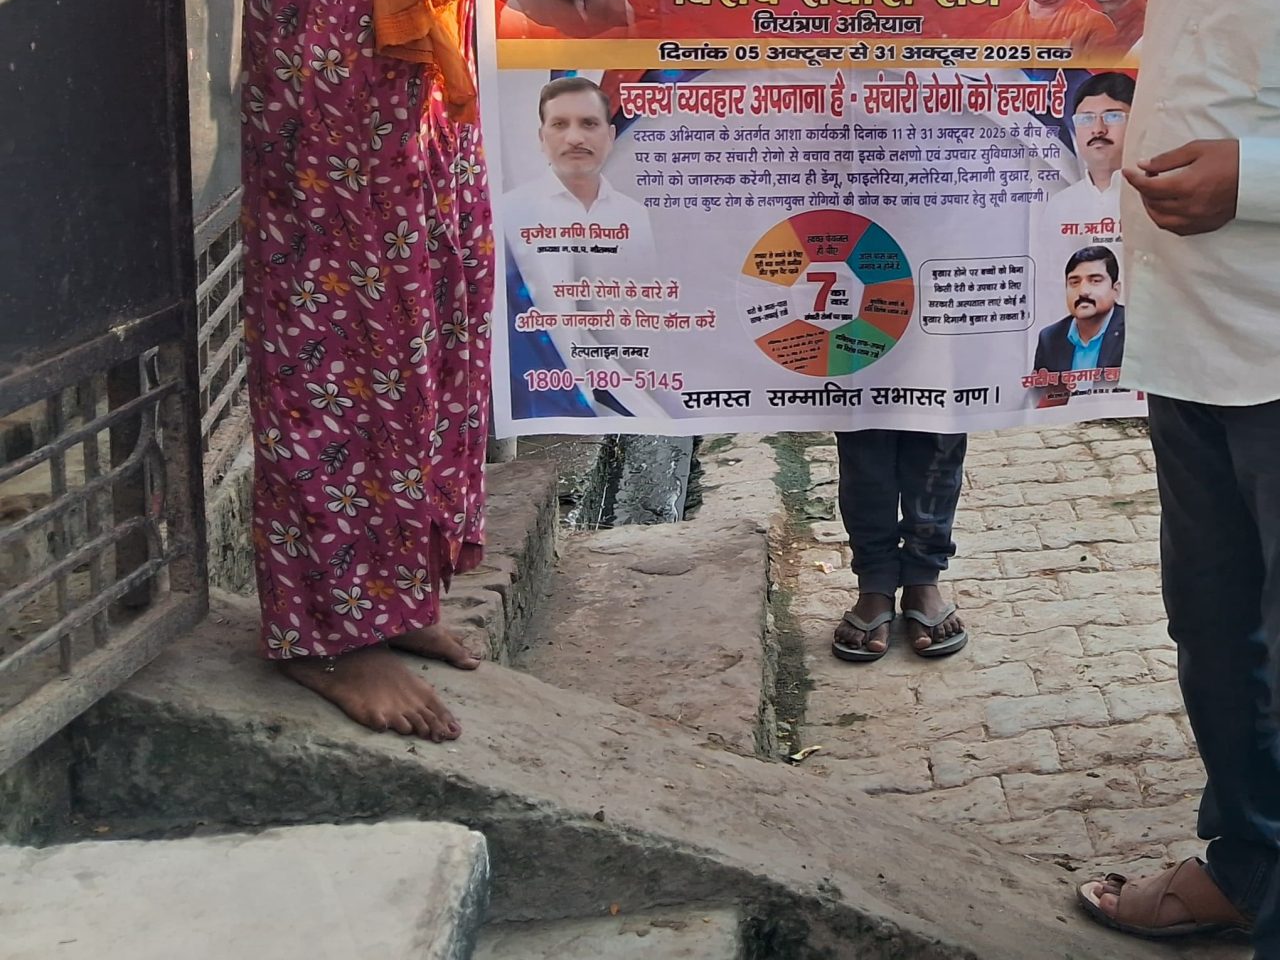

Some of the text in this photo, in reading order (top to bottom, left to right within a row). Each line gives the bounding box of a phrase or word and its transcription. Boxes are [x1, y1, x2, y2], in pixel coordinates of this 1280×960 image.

[753, 9, 924, 34] नियंत्रण अभियान
[658, 41, 1073, 67] दिनांक 05 अक्टूबर से 31 अक्टूबर 2025 तक
[619, 83, 674, 118] स्वस्थ
[676, 83, 746, 119] व्यवहार
[750, 83, 826, 116] अपनाना
[830, 69, 846, 119] है
[863, 70, 919, 115] संचारी
[922, 72, 963, 116] रोगो
[967, 72, 993, 115] को
[997, 82, 1048, 116] हराना
[1051, 68, 1067, 119] है
[633, 128, 666, 142] दस्तक
[669, 125, 716, 142] अभियान
[719, 125, 730, 141] के
[733, 125, 769, 141] अंतर्गत
[774, 128, 802, 141] आशा
[854, 124, 887, 140] दिनांक
[892, 128, 902, 139] 11
[906, 123, 916, 139] से
[920, 128, 933, 139] 31
[936, 127, 975, 144] अक्टूबर
[979, 128, 1006, 139] 2025
[1010, 122, 1020, 138] के
[1023, 122, 1042, 138] बीच
[635, 152, 650, 163] घर
[654, 151, 667, 163] का
[671, 150, 700, 164] भ्रमण
[704, 151, 722, 163] कर
[726, 147, 758, 163] संचारी
[789, 147, 799, 162] से
[803, 150, 831, 162] बचाव
[834, 149, 854, 162] तथा
[858, 146, 885, 163] इसके
[889, 146, 922, 162] लक्षणो
[926, 145, 941, 162] एवं
[944, 147, 976, 161] उपचार
[981, 144, 1025, 164] सुविधाओं
[1028, 144, 1039, 158] के
[1042, 144, 1060, 159] प्रति
[636, 169, 664, 186] लोगों
[668, 170, 684, 186] को
[805, 169, 817, 184] ही
[999, 169, 1033, 186] बुखार,
[1037, 169, 1060, 182] दस्त
[644, 196, 660, 208] क्षय
[664, 194, 680, 208] रोग
[684, 194, 697, 208] एवं
[725, 193, 742, 208] रोग
[745, 192, 755, 207] के
[757, 195, 805, 210] लक्षणयुक्त
[808, 191, 839, 207] रोगियों
[842, 190, 854, 205] की
[858, 190, 879, 206] खोज
[883, 195, 897, 206] कर
[901, 191, 920, 206] जांच
[924, 191, 937, 206] एवं
[940, 194, 969, 205] उपचार
[972, 190, 986, 208] हेतु
[989, 189, 1007, 208] सूची
[520, 222, 629, 245] वृजेश मणि त्रिपाठी
[932, 269, 952, 281] बुखार
[954, 266, 967, 278] होने
[969, 268, 979, 276] पर
[553, 279, 680, 299] संचारी रोगों के बारे में
[807, 271, 837, 312] 7
[934, 279, 1022, 293] किसी देरी के उपचार के लिए
[928, 298, 954, 308] सरकारी
[516, 309, 716, 329] अधिक जानकारी के लिए कॉल करें
[922, 315, 941, 326] बुखार
[943, 313, 967, 324] दिमागी
[969, 314, 989, 326] बुखार
[571, 342, 650, 360] हेल्पलाइन नम्बर
[524, 370, 684, 391] 1800-180-5145
[1061, 368, 1102, 392] कुमार
[681, 389, 751, 409] समस्त
[766, 382, 863, 408] सम्मानित
[869, 386, 946, 408] सभासद
